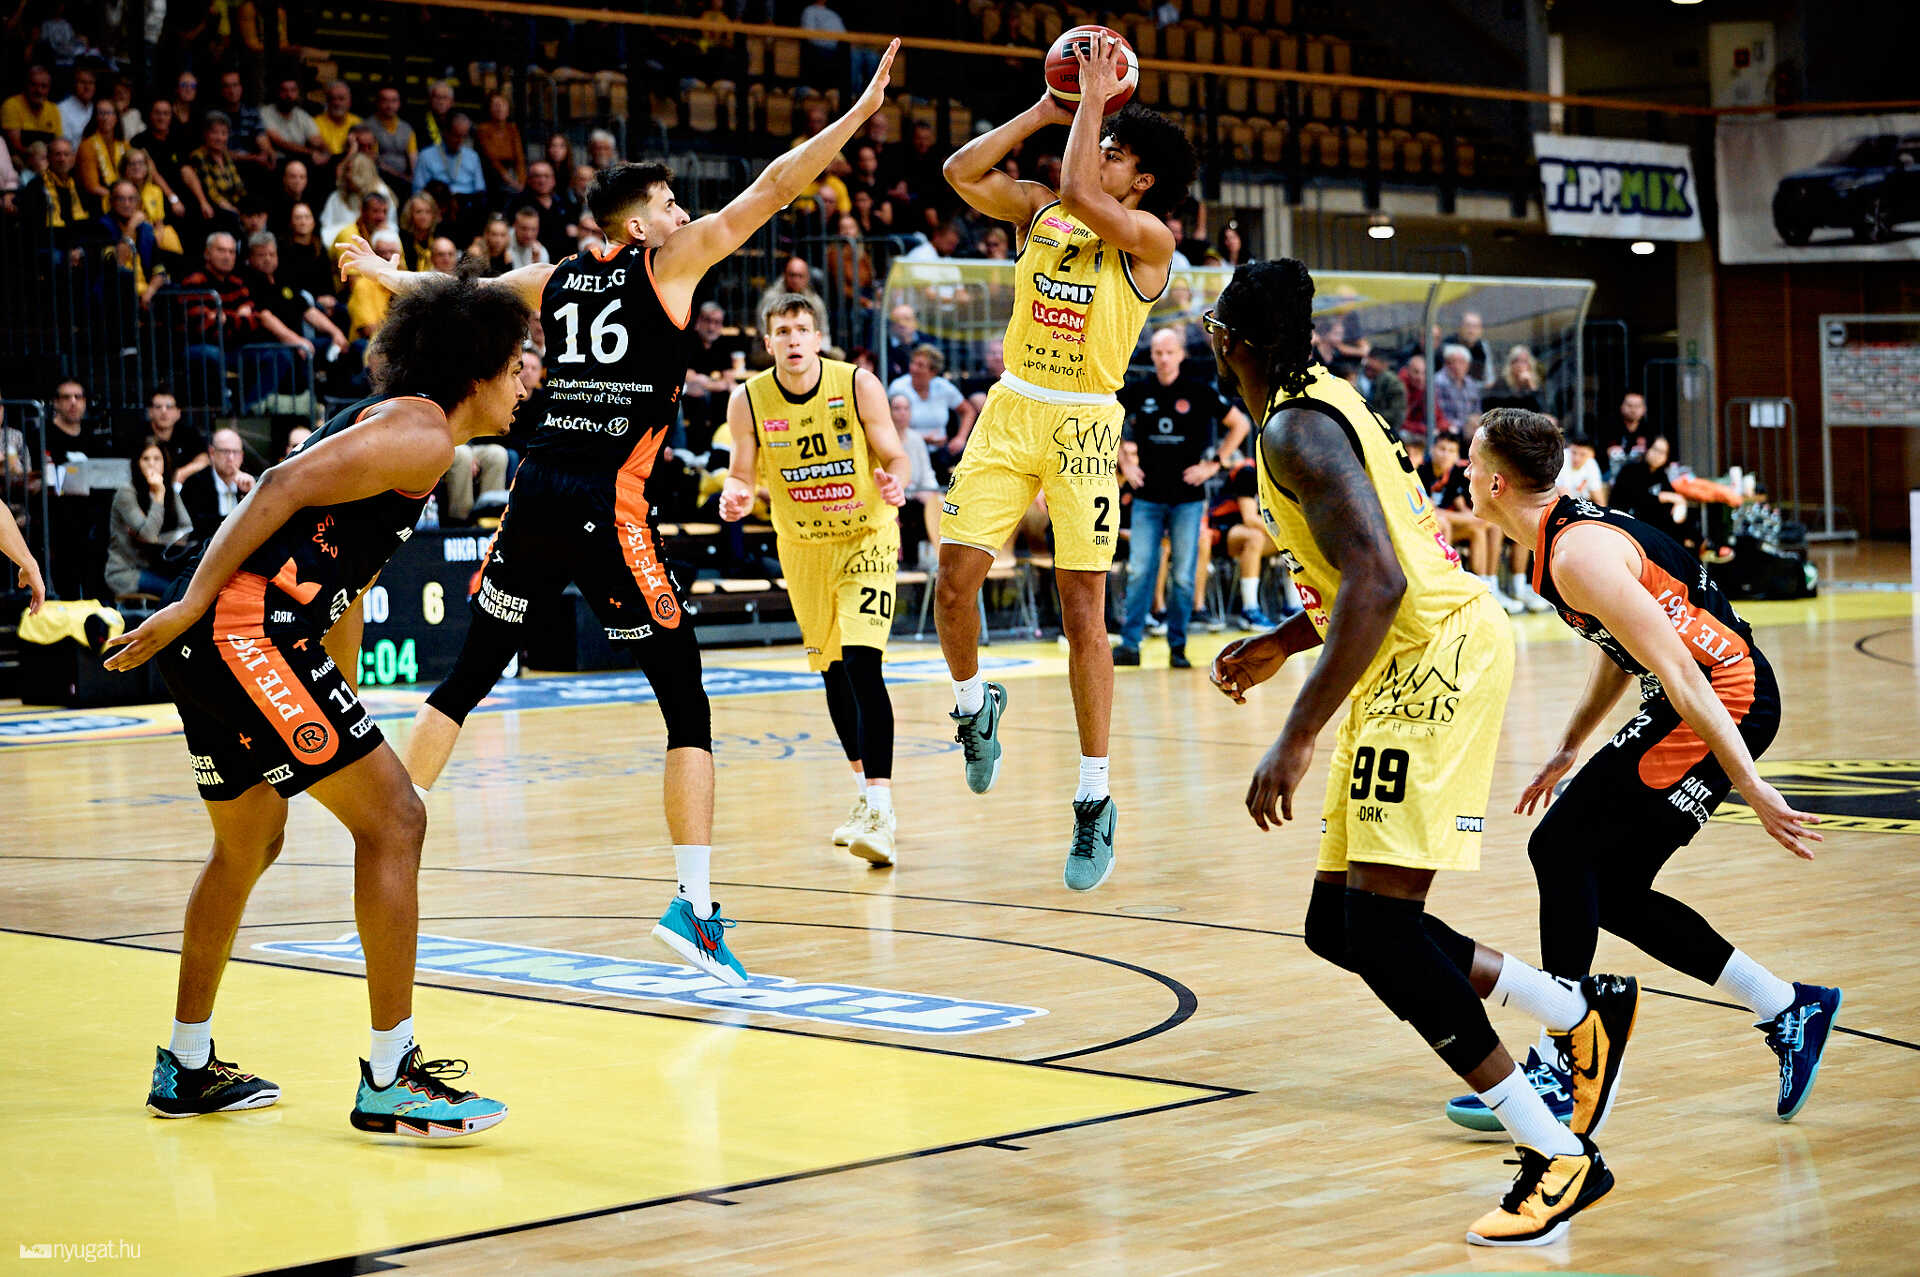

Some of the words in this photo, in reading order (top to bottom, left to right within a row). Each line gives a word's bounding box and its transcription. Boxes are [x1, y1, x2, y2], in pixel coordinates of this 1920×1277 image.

[1058, 244, 1080, 272] 2
[554, 299, 628, 364] 16
[594, 392, 605, 403] of
[607, 393, 632, 405] Pécs
[797, 433, 827, 459] 20
[789, 485, 853, 501] VULCANO
[796, 515, 867, 527] VOLVO
[1094, 496, 1110, 532] 2
[444, 537, 477, 562] NKA
[635, 556, 663, 591] PTE
[422, 581, 446, 625] 6
[859, 587, 891, 619] 20
[255, 669, 304, 722] PTE
[329, 681, 358, 713] 11
[1350, 746, 1410, 803] 99
